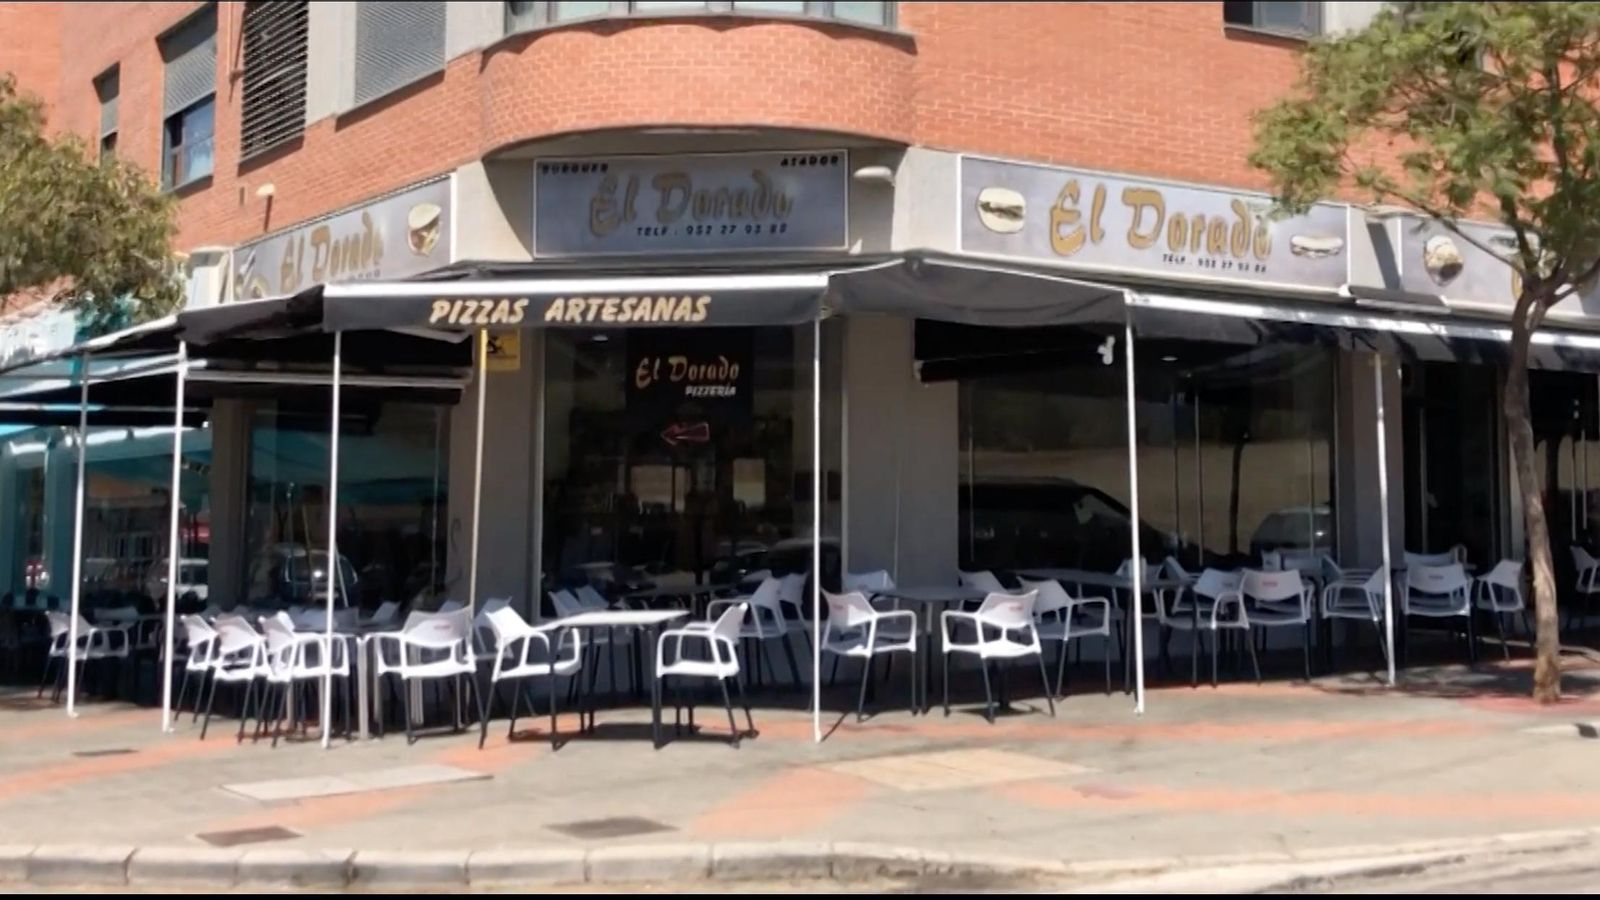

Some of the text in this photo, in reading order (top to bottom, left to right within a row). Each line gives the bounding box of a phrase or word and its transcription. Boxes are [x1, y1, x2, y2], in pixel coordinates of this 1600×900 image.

[590, 169, 793, 237] El Dorado
[1050, 179, 1273, 261] El Dorado
[281, 210, 384, 293] El Dorado
[686, 225, 713, 235] 952
[720, 224, 737, 235] 27
[429, 296, 711, 323] PIZZAS ARTESANAS
[635, 355, 739, 389] El Dorado
